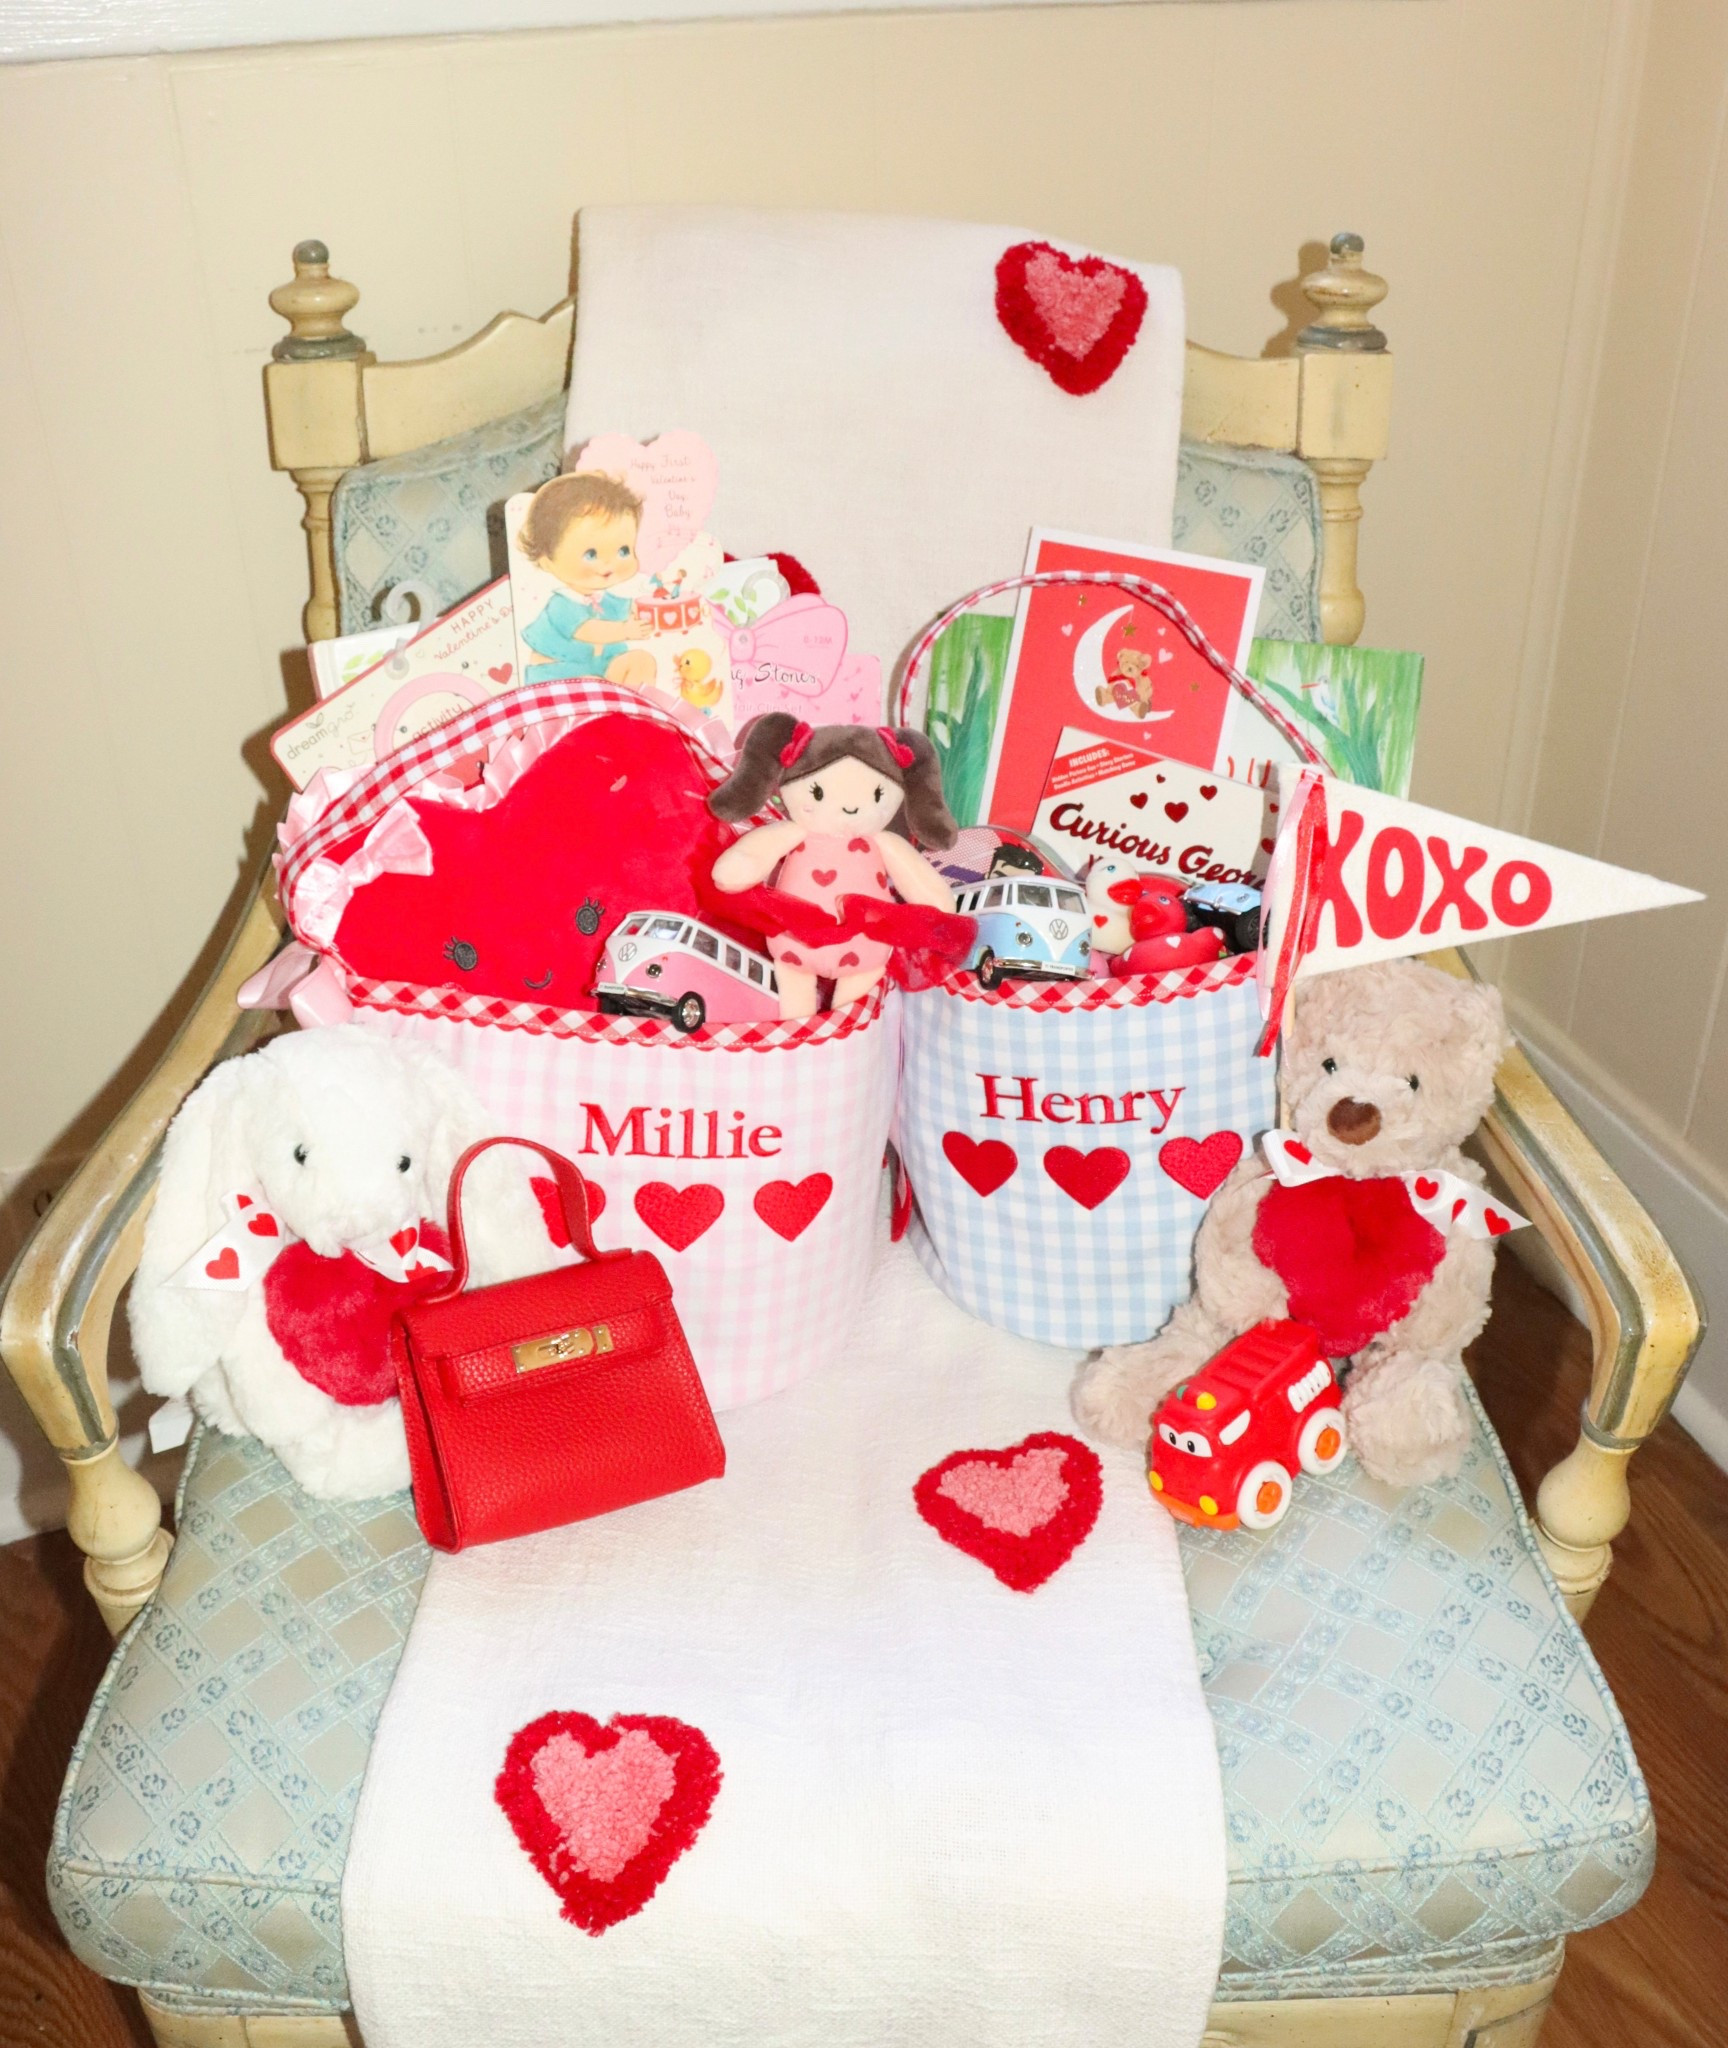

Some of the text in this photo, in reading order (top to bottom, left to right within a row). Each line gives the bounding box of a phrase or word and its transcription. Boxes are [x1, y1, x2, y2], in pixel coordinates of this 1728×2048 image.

[664, 503, 691, 521] Baby
[450, 598, 494, 634] HAPPY
[1069, 748, 1110, 768] INCLUDES:
[1050, 802, 1171, 865] Curious
[975, 1073, 1187, 1135] Henry
[577, 1102, 783, 1160] Millie
